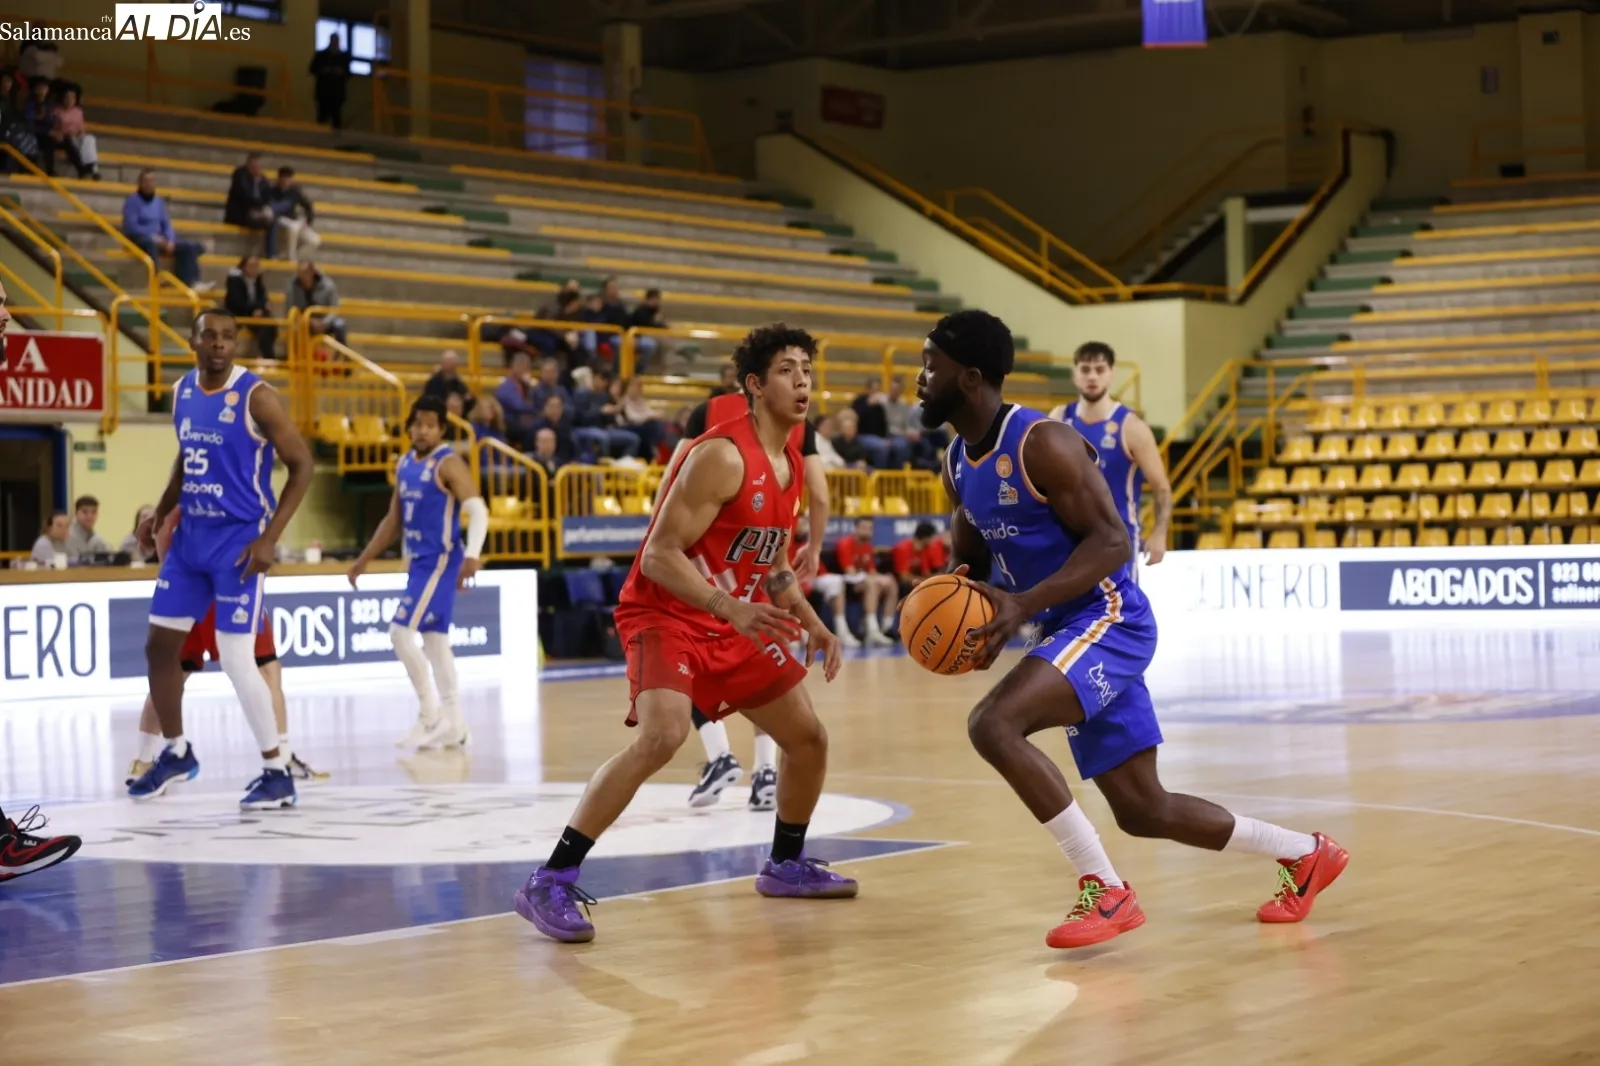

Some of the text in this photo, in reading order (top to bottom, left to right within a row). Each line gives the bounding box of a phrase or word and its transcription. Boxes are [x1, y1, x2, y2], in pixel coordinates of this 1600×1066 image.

[183, 447, 209, 475] 25
[1388, 566, 1535, 606] ABOGADOS
[1550, 562, 1580, 583] 923
[350, 597, 381, 625] 923
